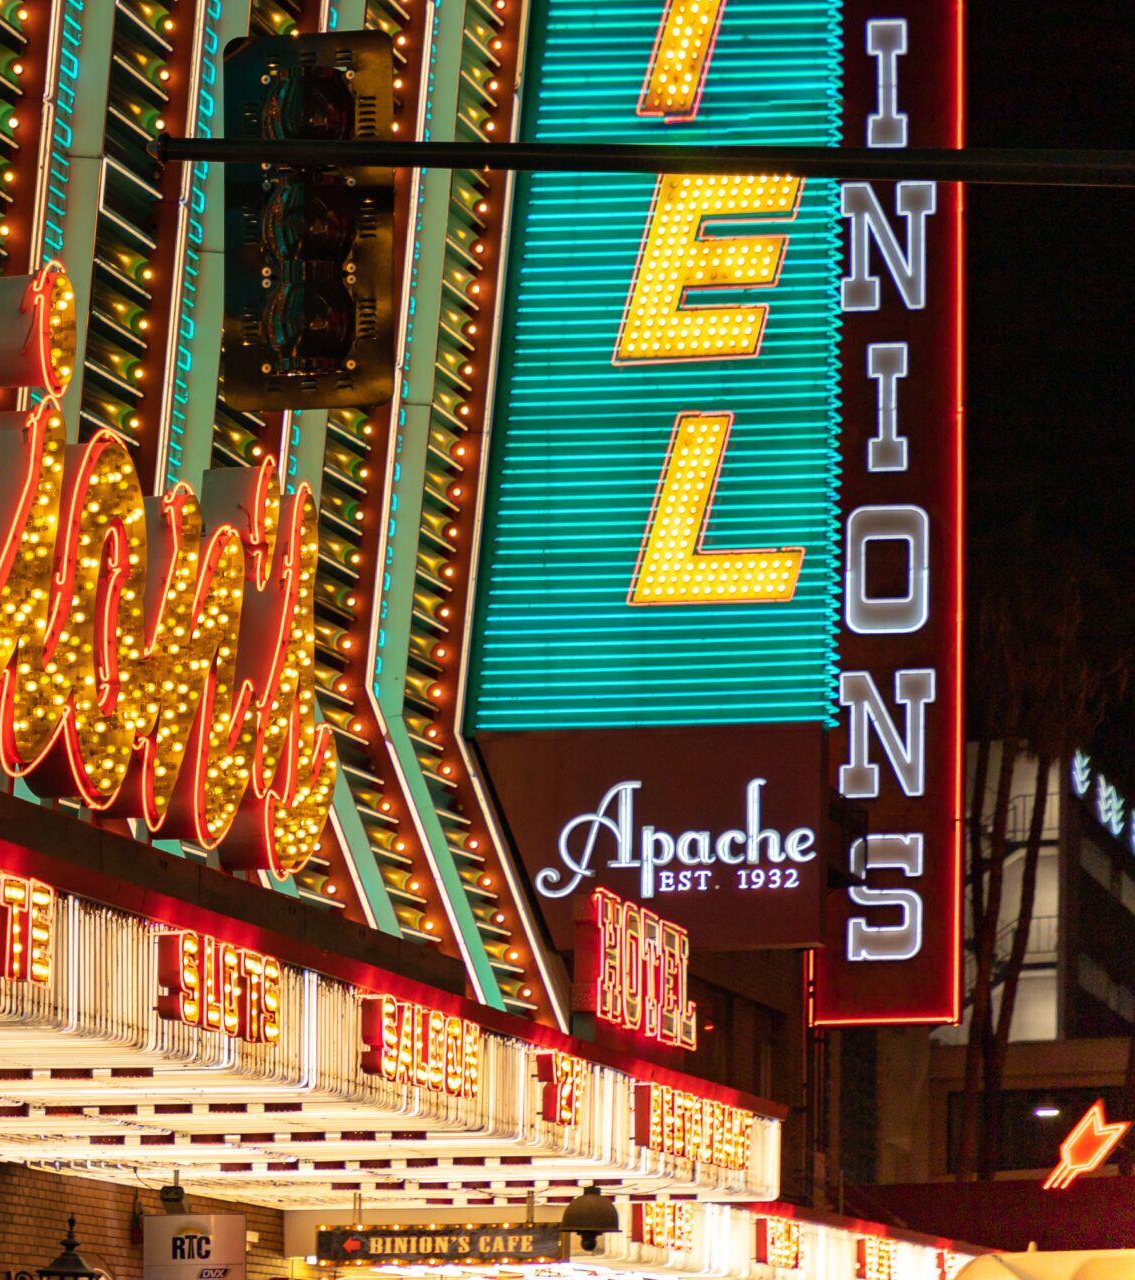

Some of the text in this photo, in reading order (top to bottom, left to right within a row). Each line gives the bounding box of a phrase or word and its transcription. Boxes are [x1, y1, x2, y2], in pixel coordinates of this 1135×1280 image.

[535, 777, 817, 898] Apache
[658, 868, 800, 891] EST. 1932
[178, 928, 281, 1045] SLOTS
[593, 887, 698, 1051] HOTEL
[381, 993, 480, 1098] SALOON
[172, 1233, 211, 1260] RTC
[202, 1269, 225, 1278] DVX
[368, 1234, 534, 1255] BINION'S CAFE
